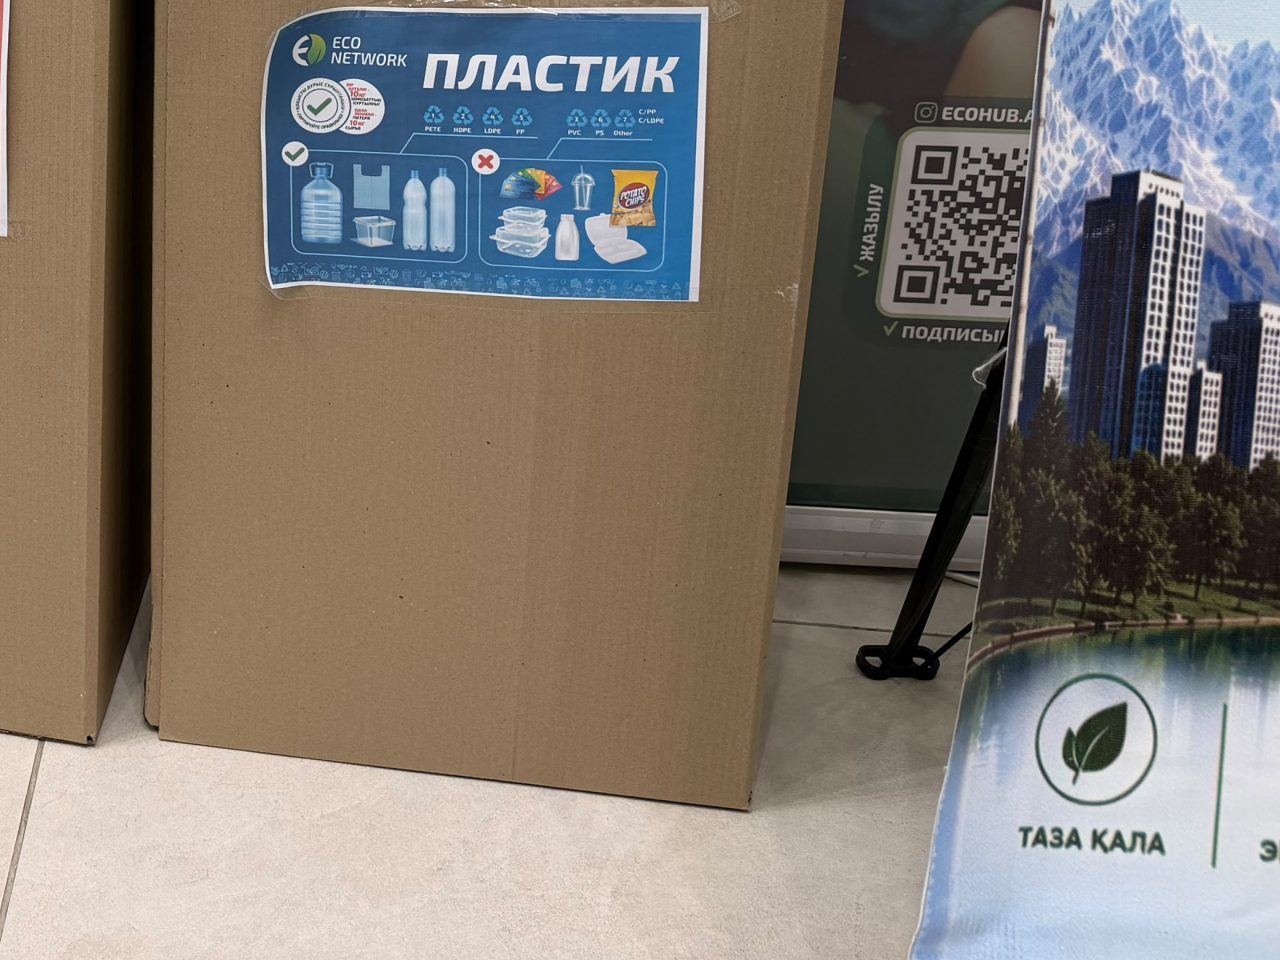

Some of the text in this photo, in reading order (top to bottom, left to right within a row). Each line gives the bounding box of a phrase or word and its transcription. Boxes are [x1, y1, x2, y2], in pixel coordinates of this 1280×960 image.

[332, 36, 361, 50] ECO
[331, 52, 408, 67] NETWORK
[422, 53, 680, 94] ПЛАСТИК
[620, 186, 647, 201] POTATO
[625, 196, 645, 207] CHIPS
[859, 184, 884, 261] ЖАЗЫЛУ
[1018, 826, 1082, 851] ТАЗА
[1091, 828, 1166, 856] ҚАЛА
[1259, 839, 1280, 863] Э
